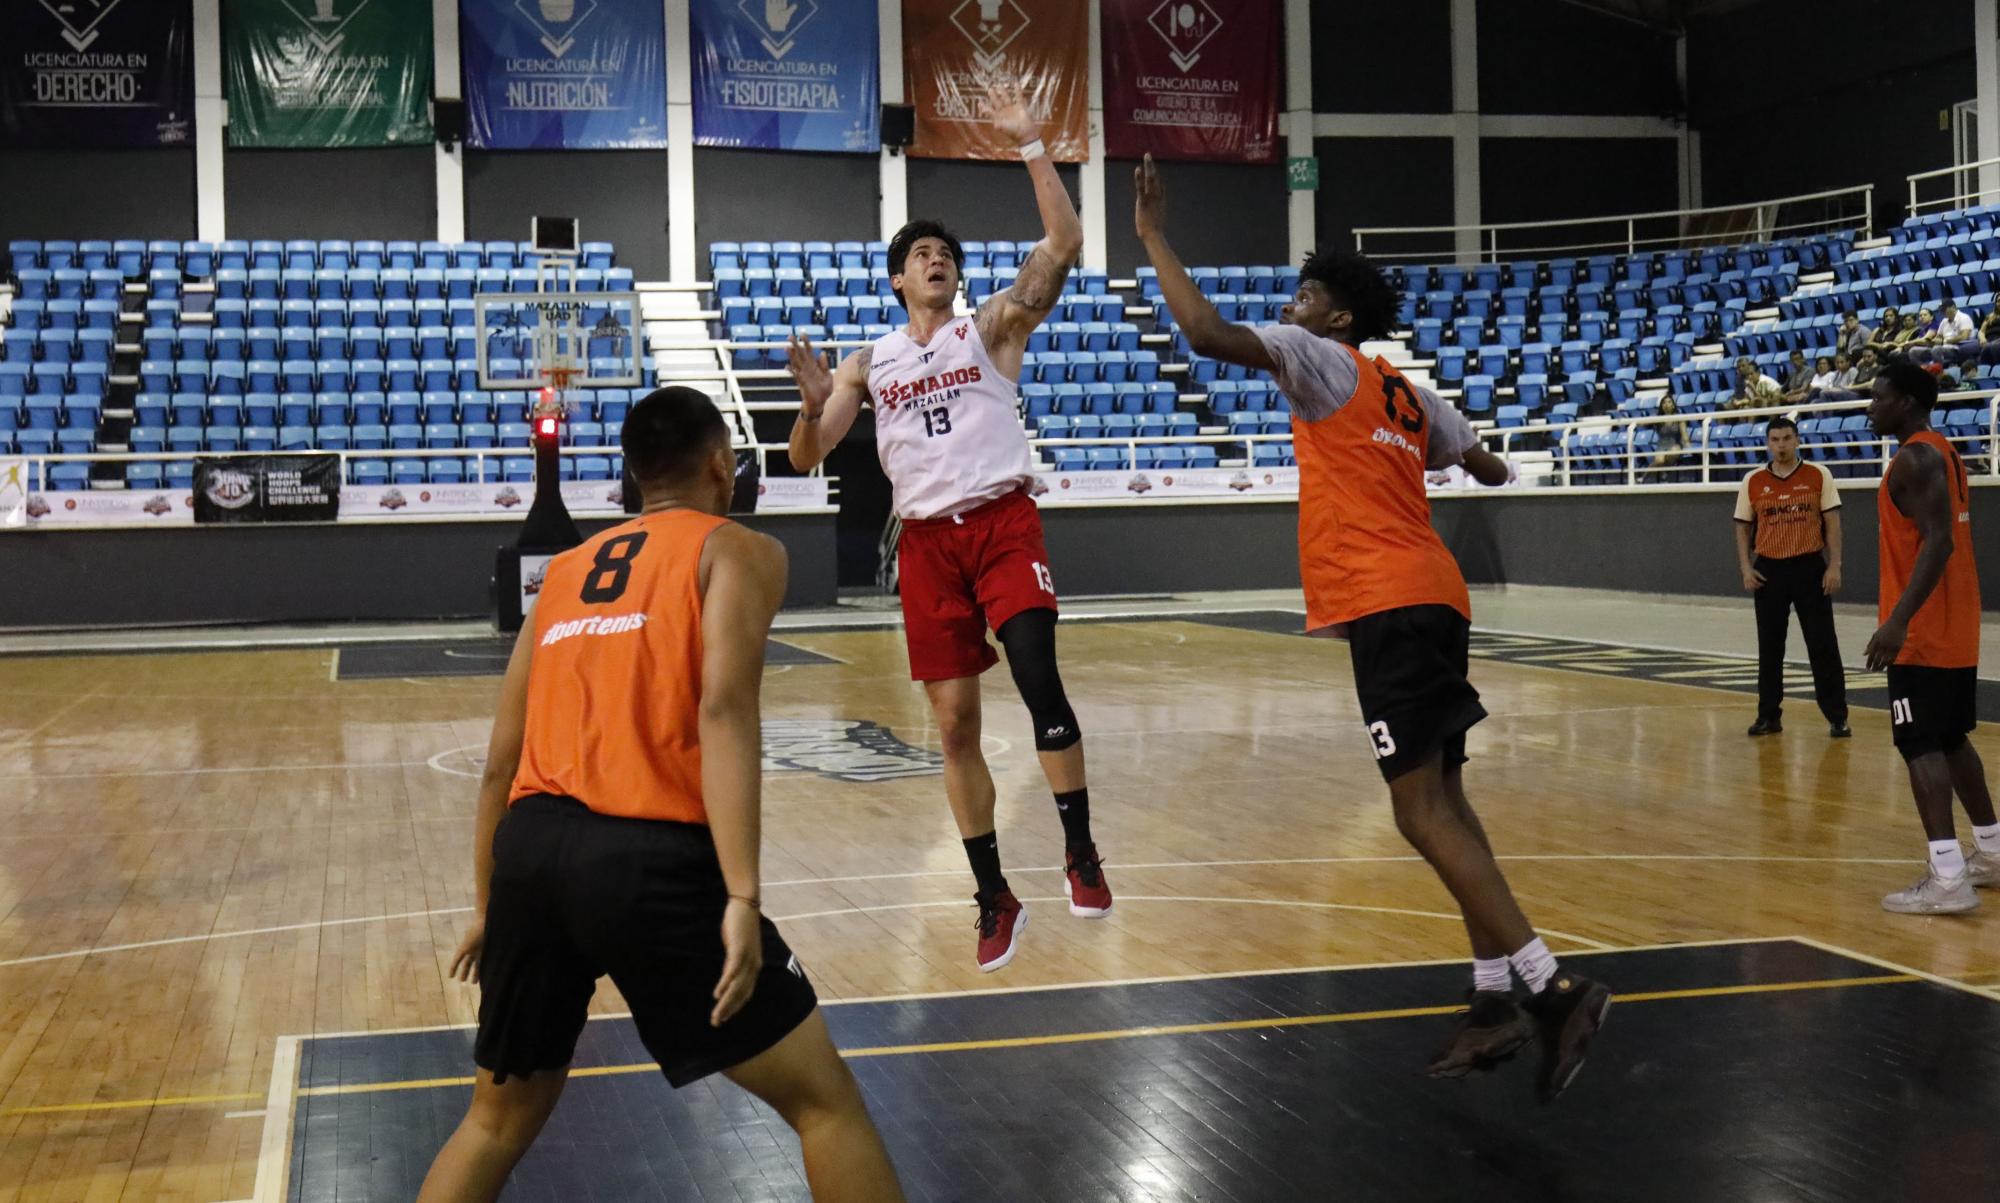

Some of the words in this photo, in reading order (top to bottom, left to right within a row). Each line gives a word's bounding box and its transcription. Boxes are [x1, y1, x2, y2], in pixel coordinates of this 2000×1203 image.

[25, 53, 125, 67] LICENCIATURA
[128, 53, 147, 67] EN
[506, 58, 598, 73] LICENCIATURA
[602, 59, 620, 73] EN
[728, 60, 817, 76] LICENCIATURA
[820, 63, 837, 76] EN
[37, 73, 135, 101] DERECHO
[509, 77, 608, 107] NUTRICIÓN
[724, 80, 839, 108] FISIOTERAPIA
[1136, 76, 1220, 92] LICENCIATURA
[1222, 80, 1239, 92] EN
[923, 406, 952, 438] 13
[268, 471, 302, 479] WORLD
[268, 486, 321, 495] CHALLENGE
[580, 531, 648, 604] 8
[1032, 561, 1055, 595] 13
